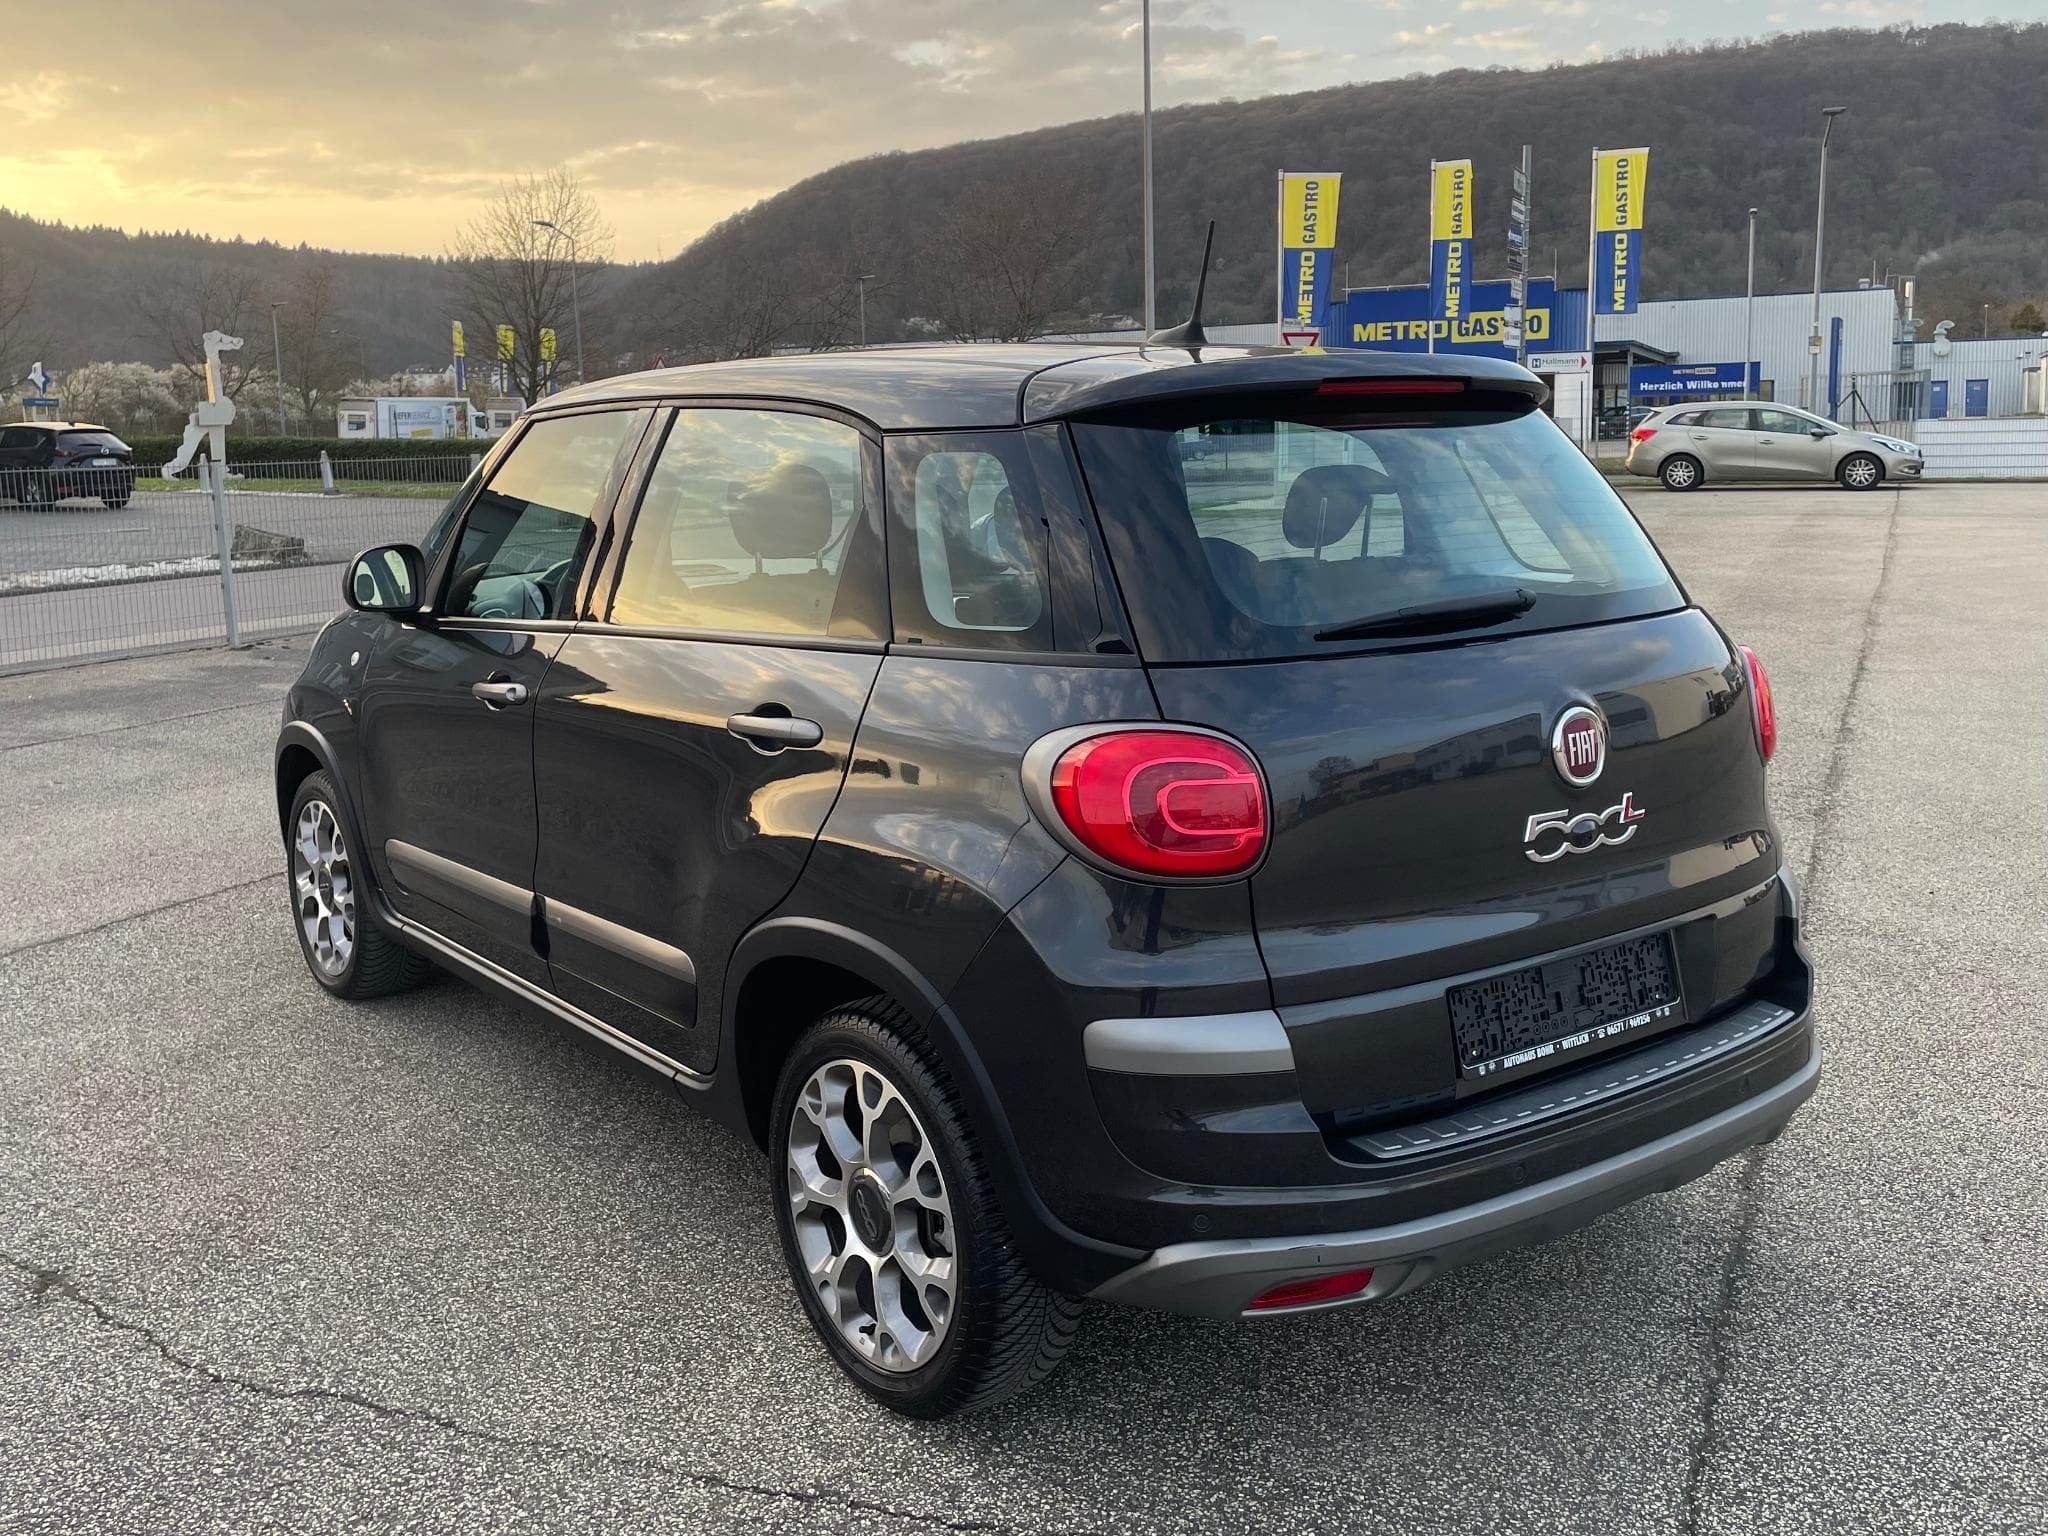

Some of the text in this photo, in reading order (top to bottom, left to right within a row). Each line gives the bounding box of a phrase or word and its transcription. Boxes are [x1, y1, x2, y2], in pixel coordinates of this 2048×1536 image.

[1298, 180, 1320, 324] METRO GASTRO
[1445, 168, 1465, 318] METRO GASTRO
[1613, 157, 1629, 312] METRO GASTRO
[1352, 314, 1543, 342] METRO GASO
[1542, 357, 1579, 366] Hallmann
[1639, 380, 1683, 391] Herzlich
[1567, 728, 1596, 767] FIAT
[1503, 1050, 1537, 1069] AUTOHAUS
[1562, 1033, 1590, 1050] WITTLICH
